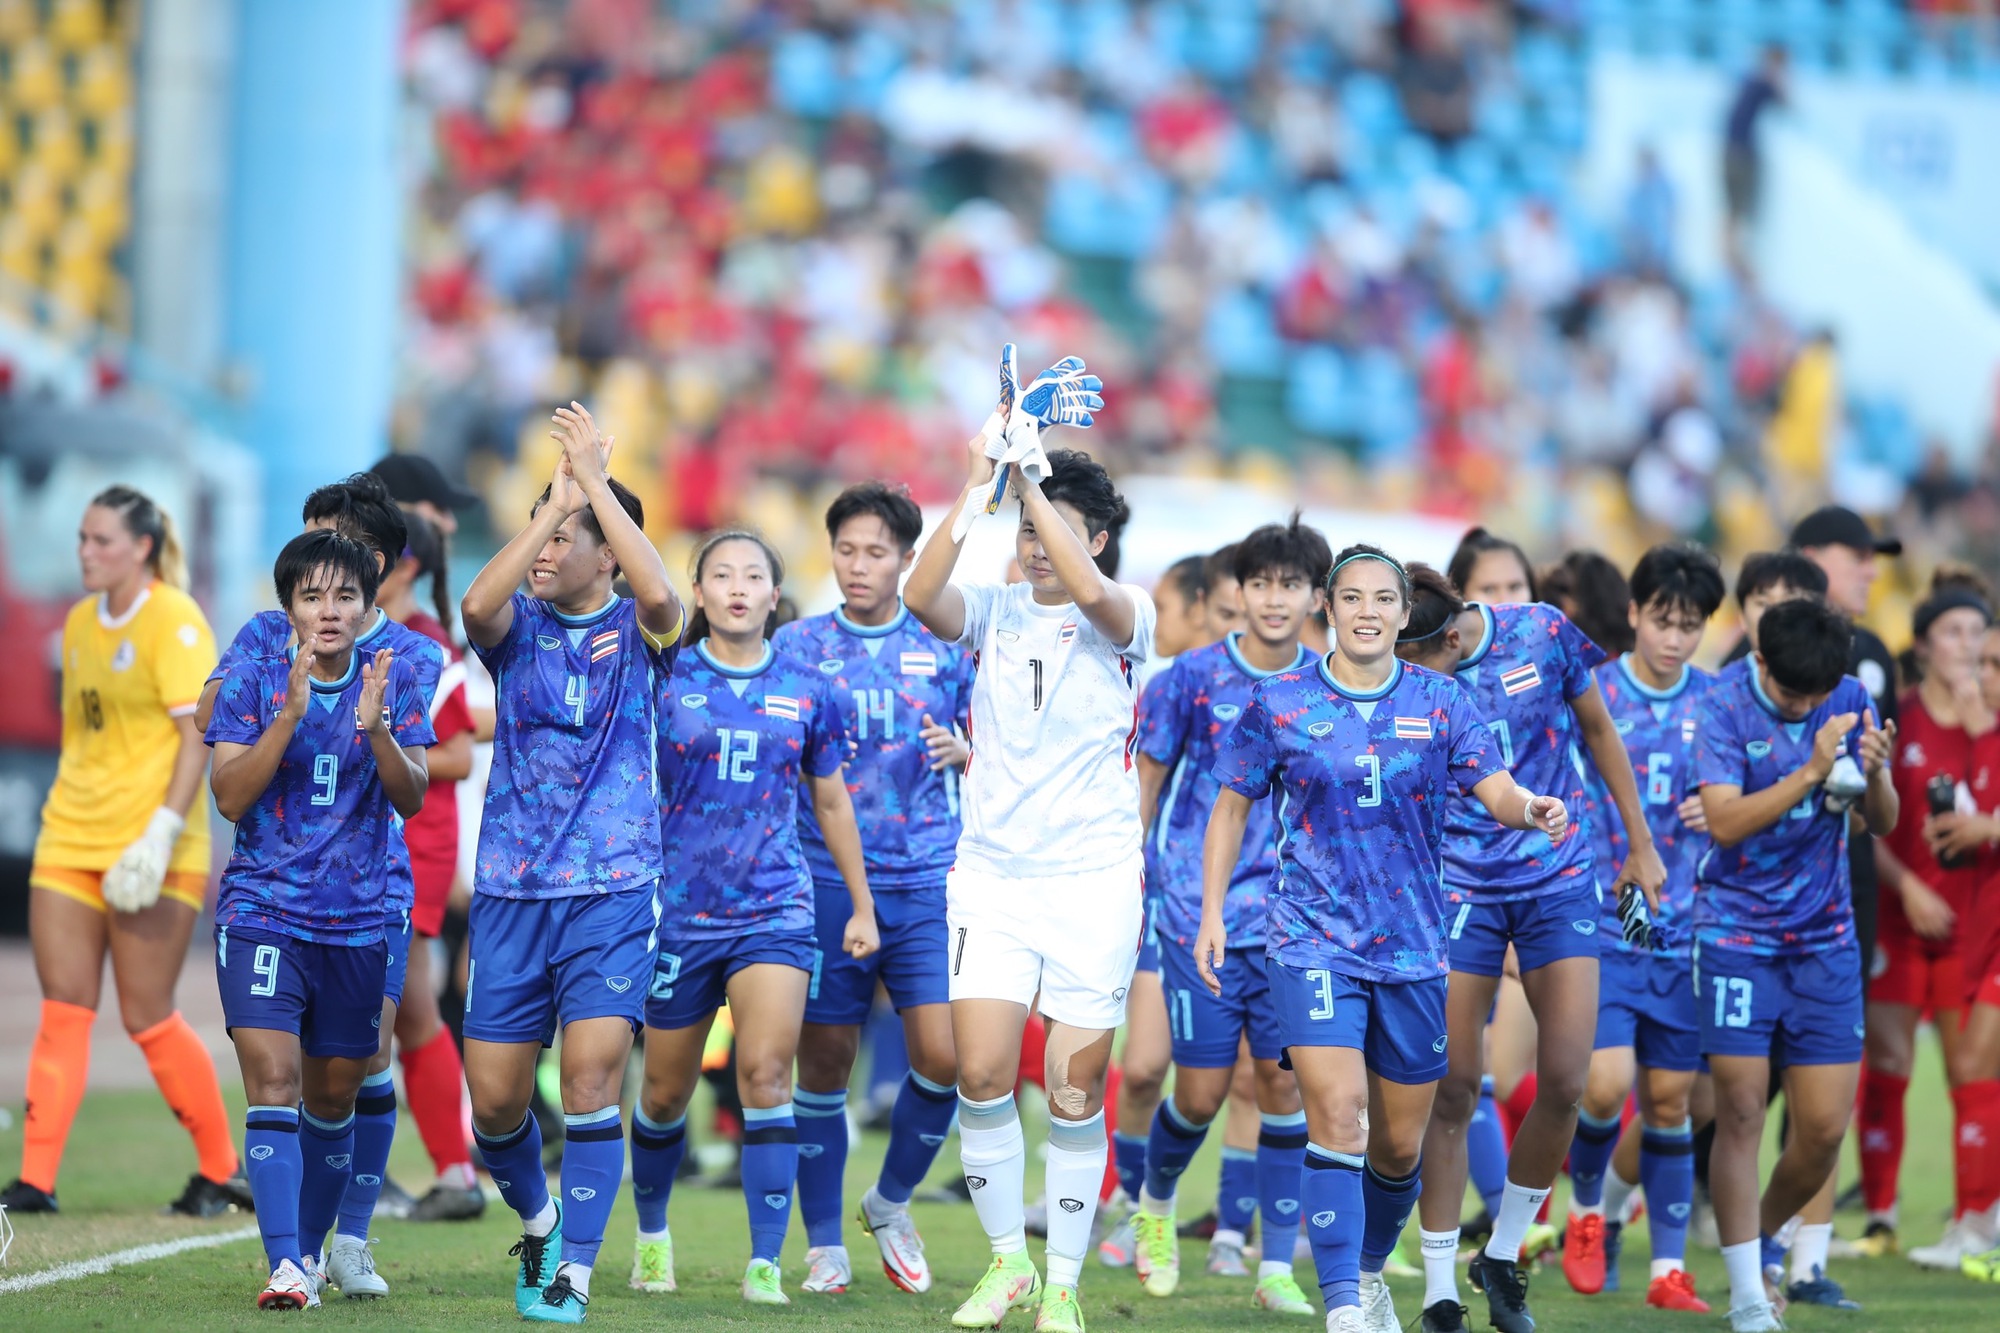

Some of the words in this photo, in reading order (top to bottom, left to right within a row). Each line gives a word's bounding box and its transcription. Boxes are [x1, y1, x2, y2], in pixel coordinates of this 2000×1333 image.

[565, 675, 586, 726] 4
[1029, 659, 1042, 711] 1
[852, 688, 894, 739] 14
[311, 754, 339, 805] 9
[716, 728, 758, 782] 12
[1647, 752, 1672, 805] 6
[1354, 755, 1381, 807] 3
[250, 945, 280, 997] 9
[954, 927, 967, 976] 1
[1306, 970, 1334, 1020] 3
[1712, 976, 1753, 1027] 13
